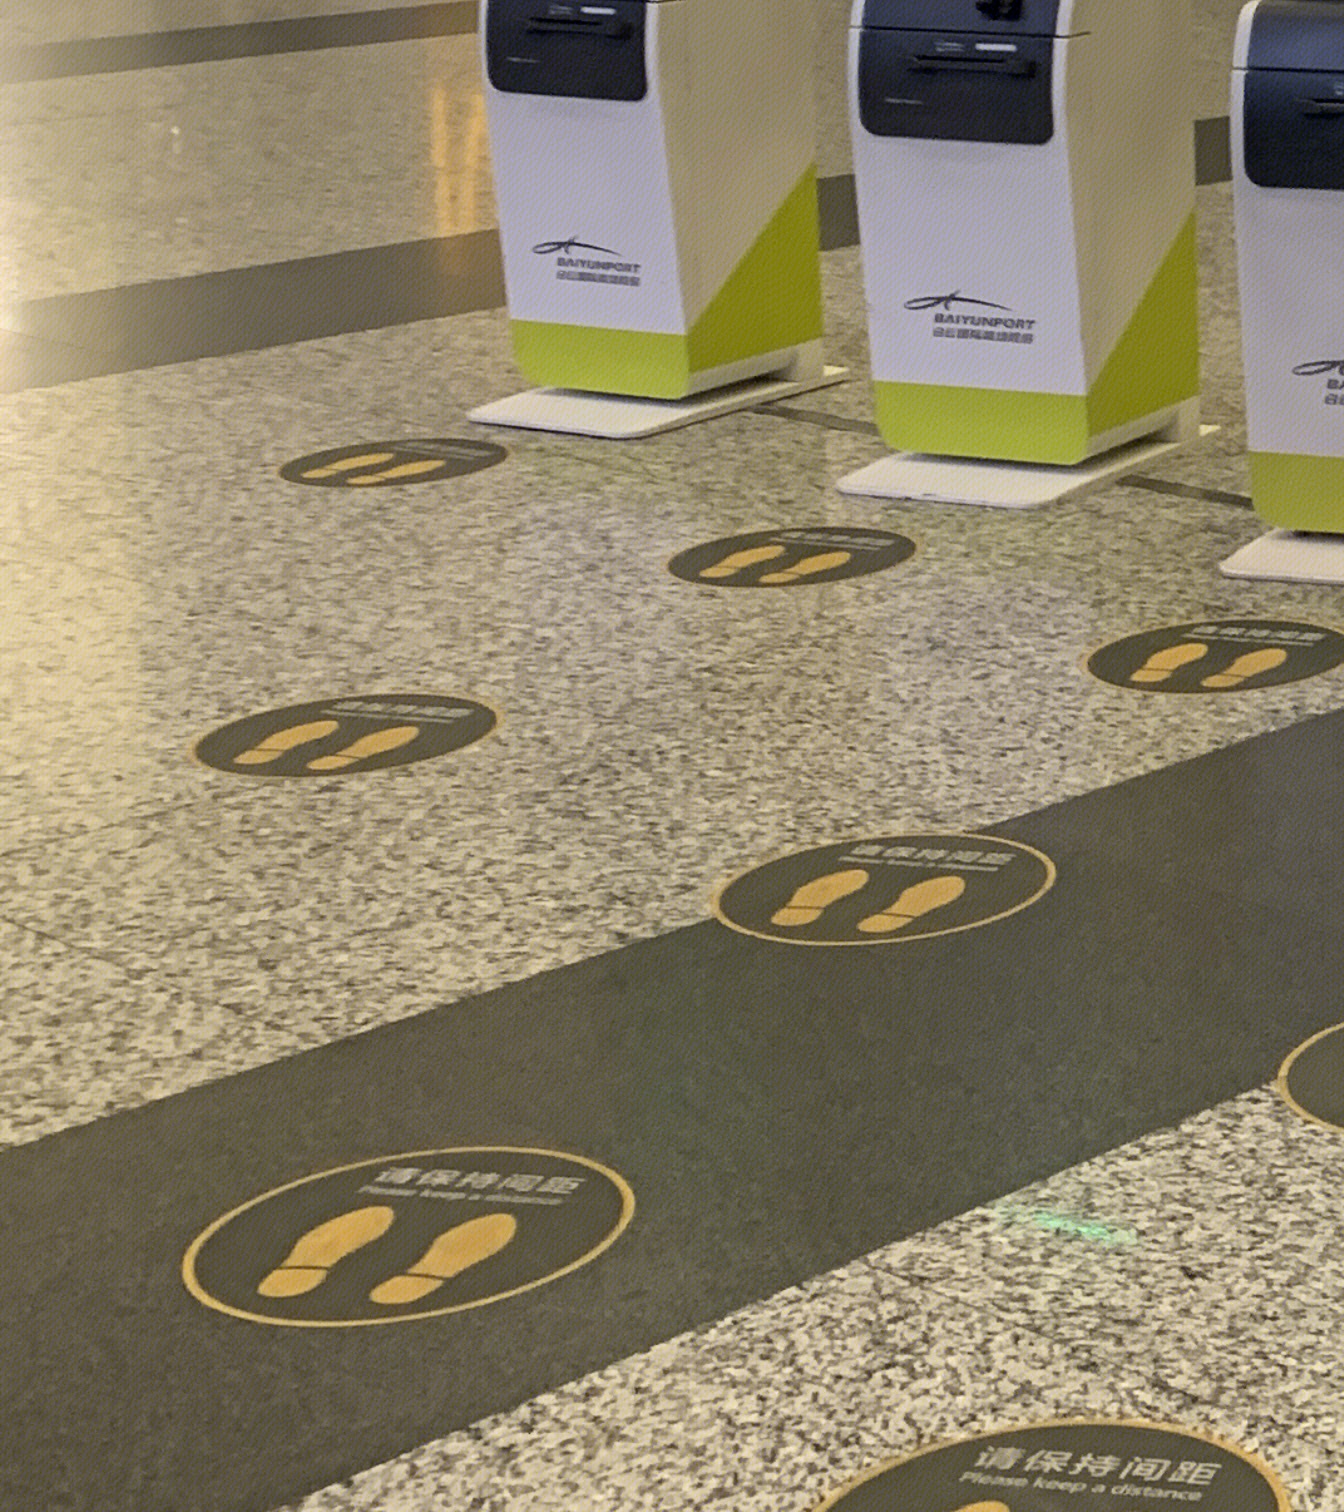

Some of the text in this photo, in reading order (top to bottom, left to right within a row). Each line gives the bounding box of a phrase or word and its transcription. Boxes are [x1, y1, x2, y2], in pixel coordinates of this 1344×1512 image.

[934, 313, 1036, 329] BAIYUNPORT
[973, 1444, 1223, 1487] 请保持间距
[958, 1469, 1030, 1488] Please
[1032, 1476, 1089, 1493] keep
[1110, 1483, 1204, 1503] distance
